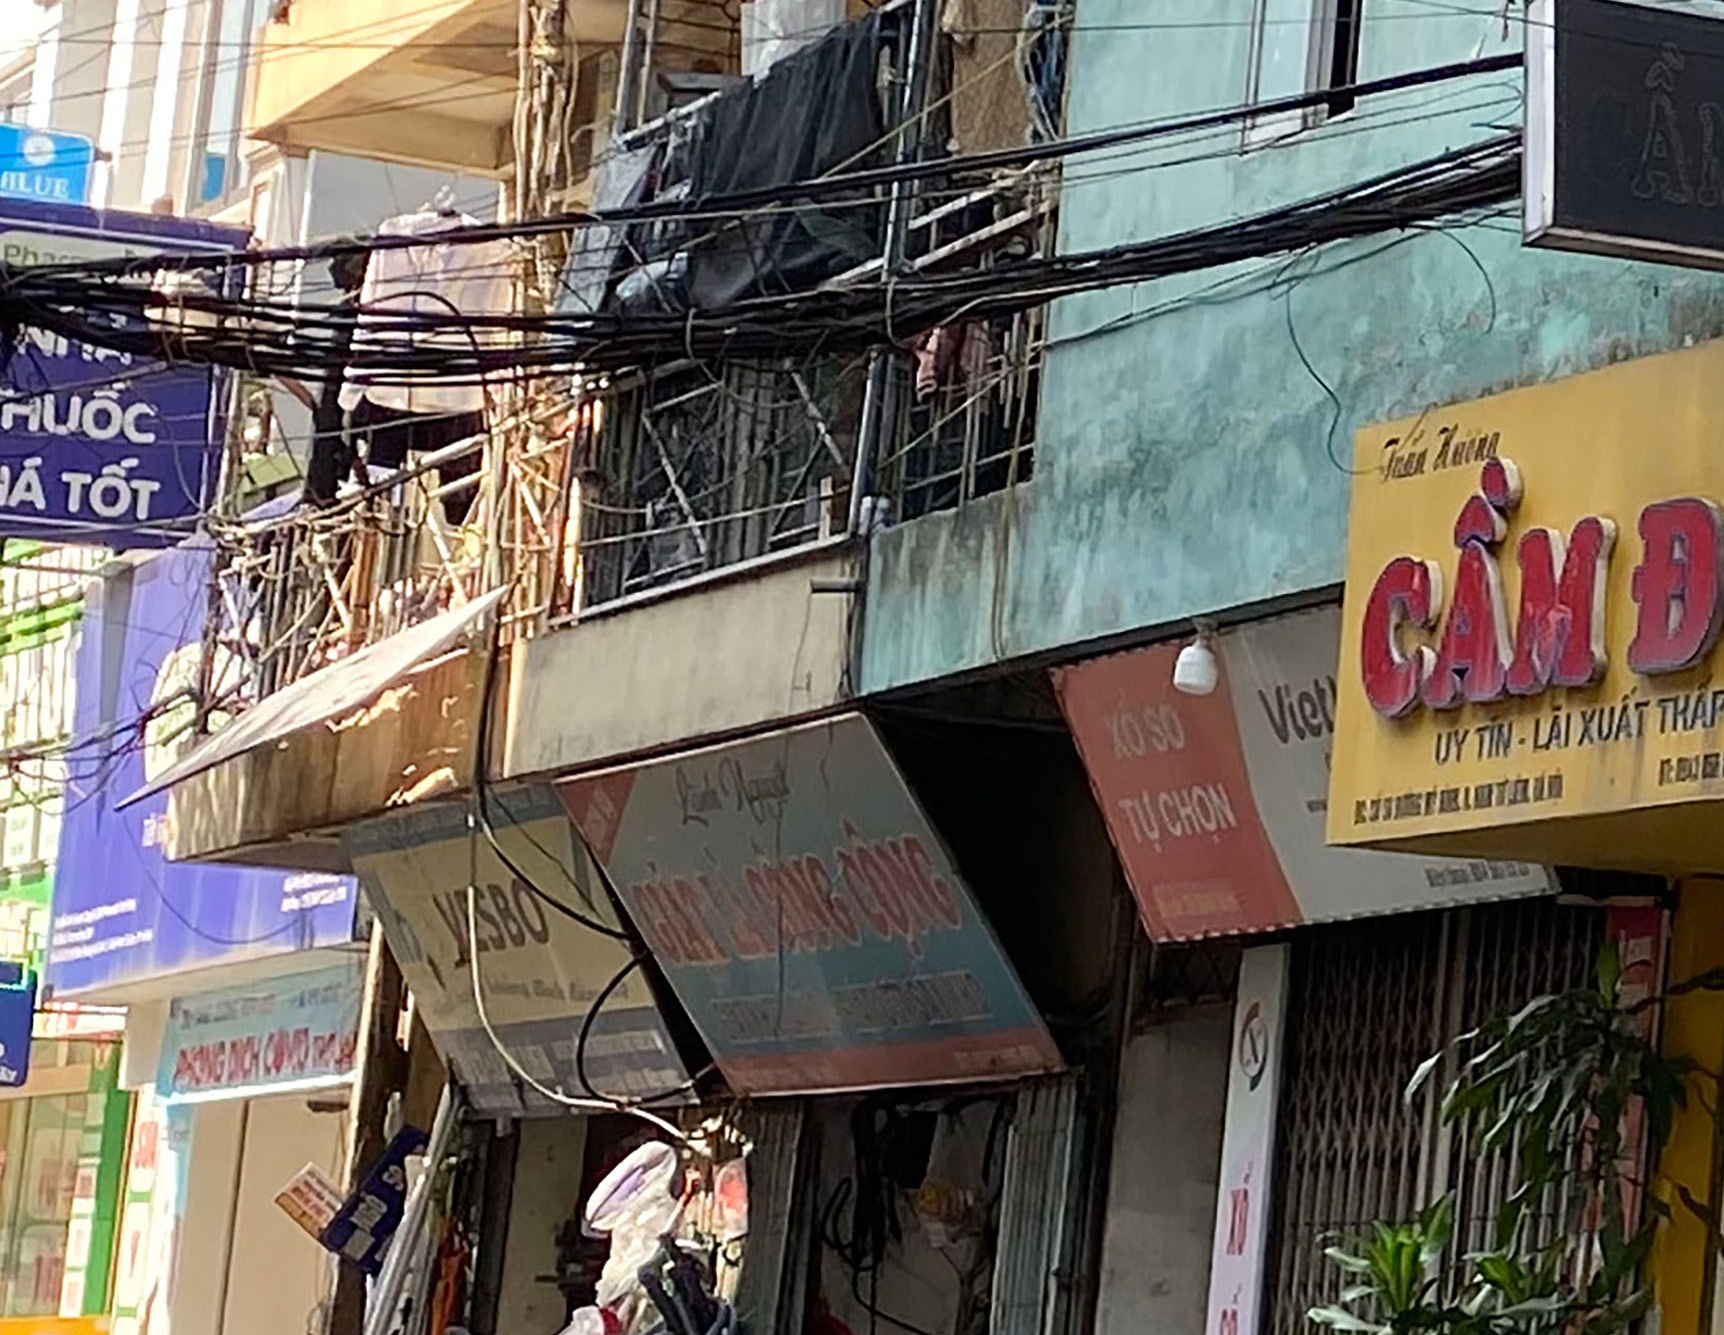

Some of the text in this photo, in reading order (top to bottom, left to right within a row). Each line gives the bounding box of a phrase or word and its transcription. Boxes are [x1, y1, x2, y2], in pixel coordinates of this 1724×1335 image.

[0, 382, 156, 444] HUỐC
[61, 458, 160, 520] TỐT
[1362, 456, 1617, 718] CẦM
[1435, 730, 1470, 766] UY
[1476, 717, 1511, 759] TÍN
[1533, 705, 1571, 752] LÃI
[1577, 689, 1651, 746] XUẤT
[1119, 784, 1237, 853] TỰ CHỌN
